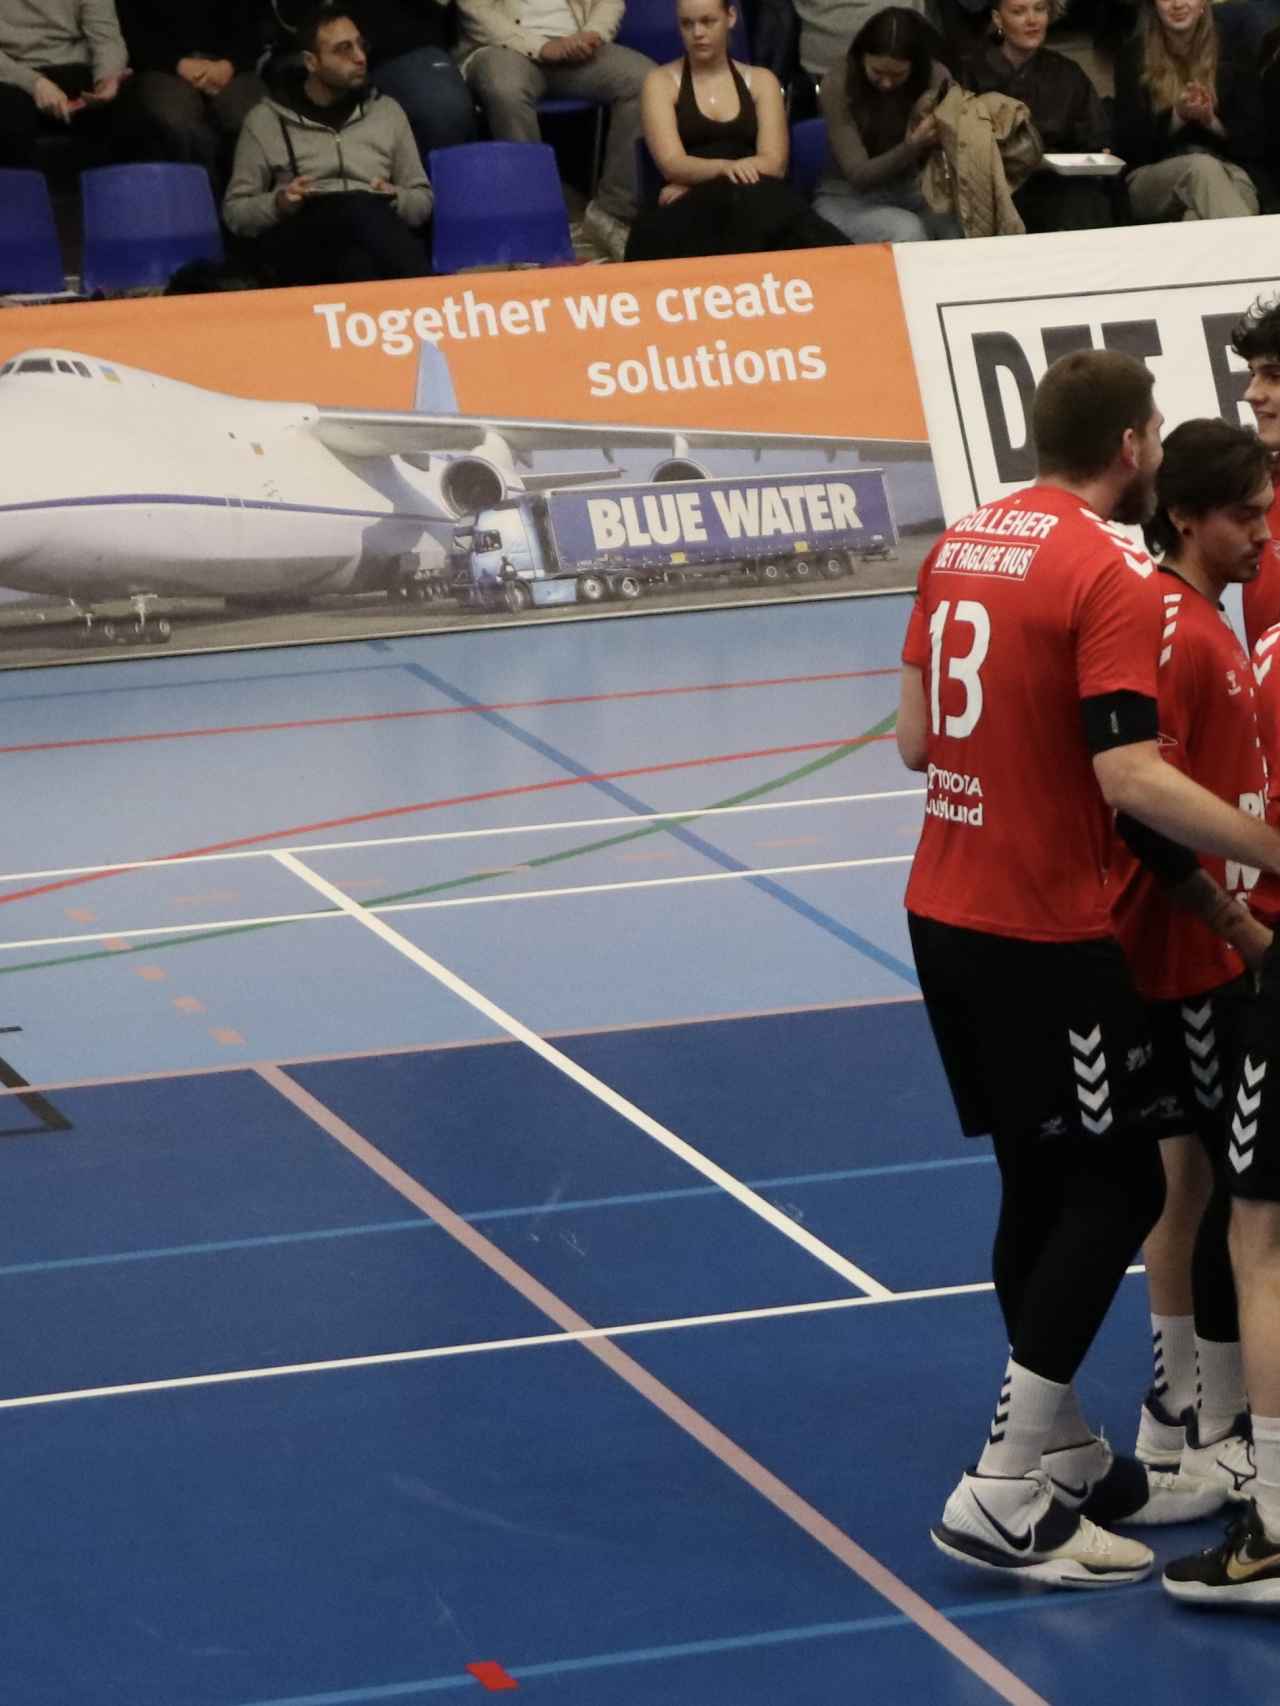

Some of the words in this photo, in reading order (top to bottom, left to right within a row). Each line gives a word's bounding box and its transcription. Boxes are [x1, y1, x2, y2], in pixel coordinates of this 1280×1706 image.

[313, 291, 550, 356] Together
[565, 289, 640, 329] we
[656, 273, 814, 323] create
[588, 344, 827, 397] solutions
[972, 318, 1162, 483] DT
[587, 492, 708, 550] BLUE
[711, 483, 863, 540] WATER
[998, 547, 1033, 575] HUS
[929, 600, 991, 739] 13
[936, 768, 984, 798] TOOTA
